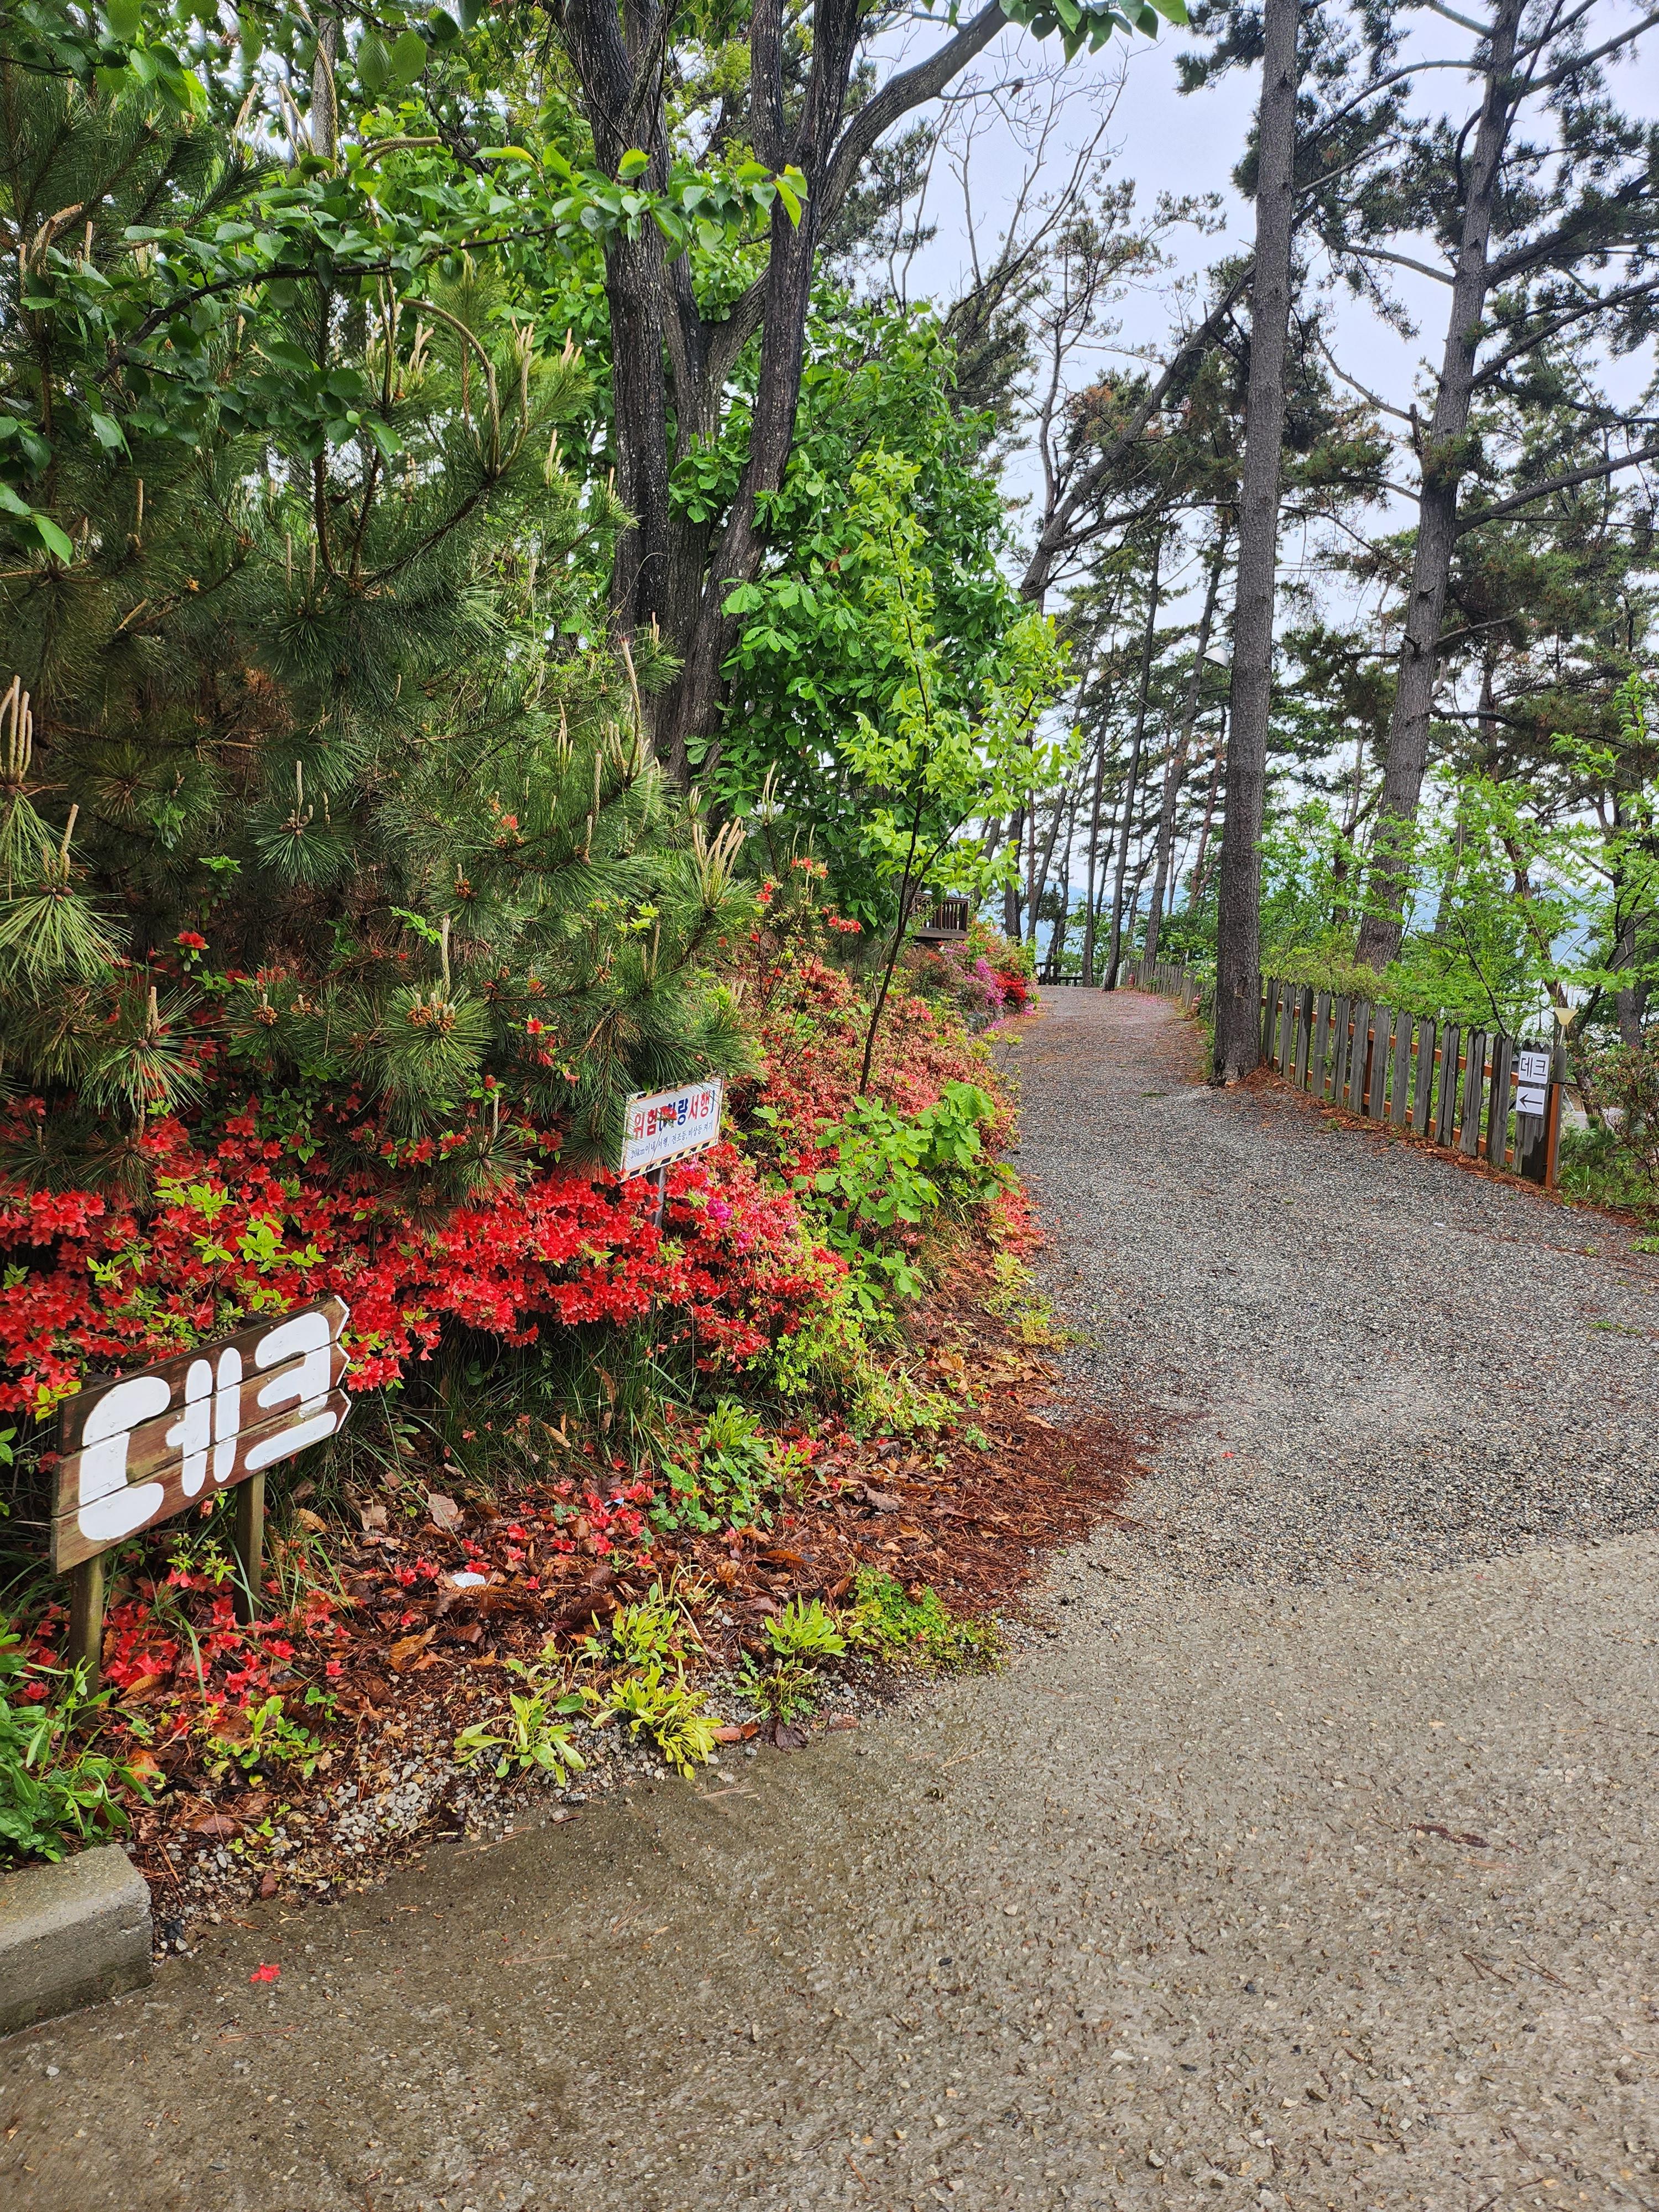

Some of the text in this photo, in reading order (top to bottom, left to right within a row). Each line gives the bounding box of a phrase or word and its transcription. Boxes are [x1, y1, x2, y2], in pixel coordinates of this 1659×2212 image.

[1520, 1057, 1546, 1078] 데크
[688, 1124, 702, 1137] 비상등
[78, 1312, 337, 1540] 데크
